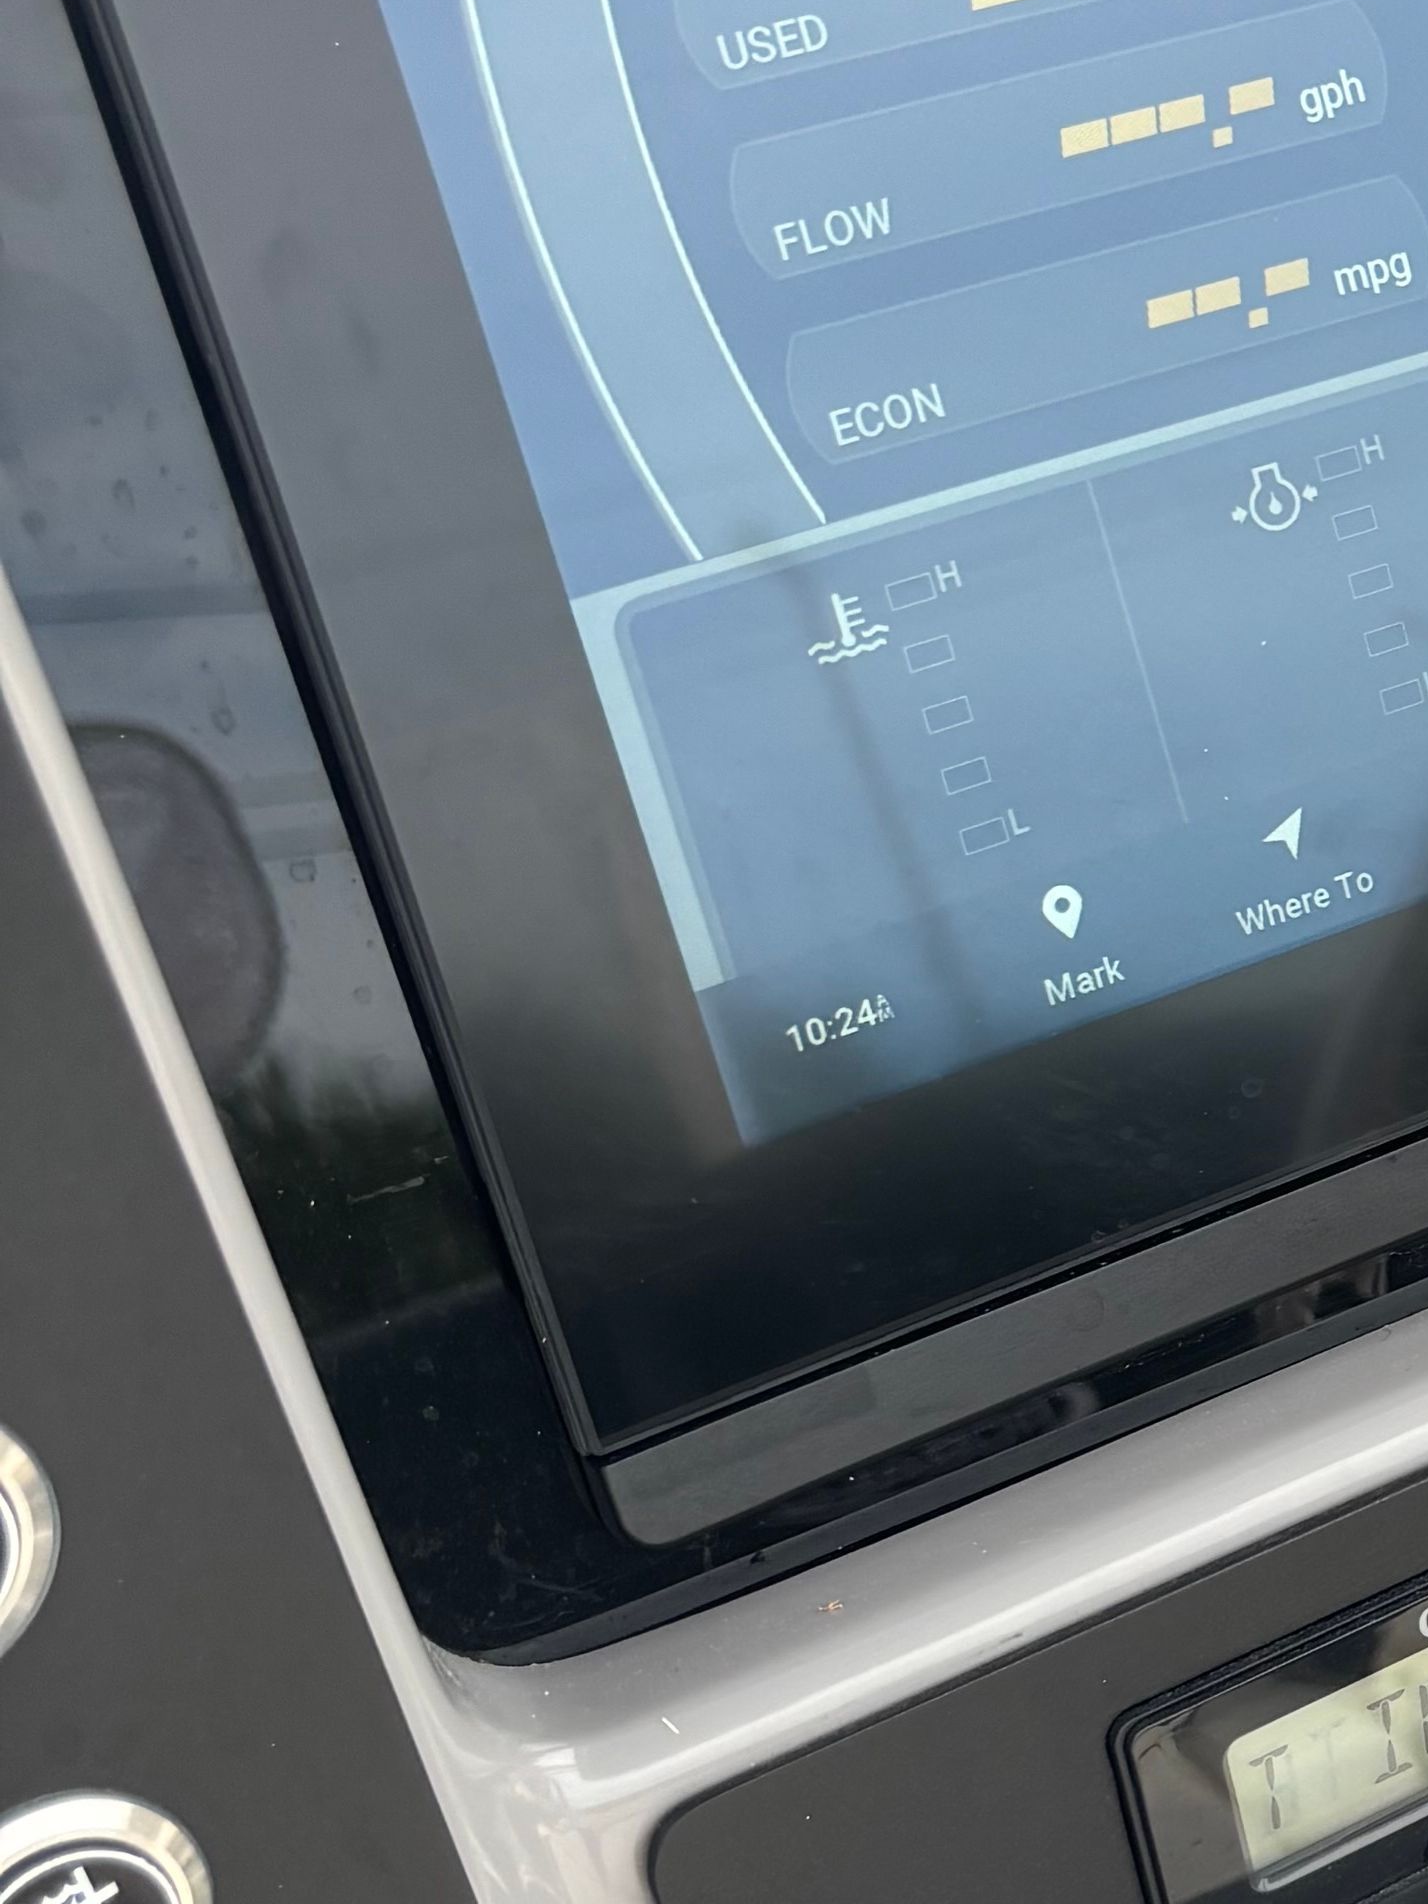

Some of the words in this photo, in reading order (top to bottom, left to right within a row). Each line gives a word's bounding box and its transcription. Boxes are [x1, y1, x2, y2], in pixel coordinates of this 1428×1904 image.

[716, 14, 829, 72] USED
[1299, 70, 1367, 123] gph
[773, 197, 894, 261] FLOW
[1333, 250, 1413, 299] mpg
[829, 382, 946, 447] ECON
[1360, 434, 1386, 466] H
[936, 561, 963, 594] H
[1007, 807, 1031, 838] L
[1236, 881, 1331, 937] Where
[1333, 866, 1375, 906] To
[1043, 955, 1126, 1007] Mark
[785, 998, 877, 1052] 10:24
[1250, 1743, 1288, 1831] T
